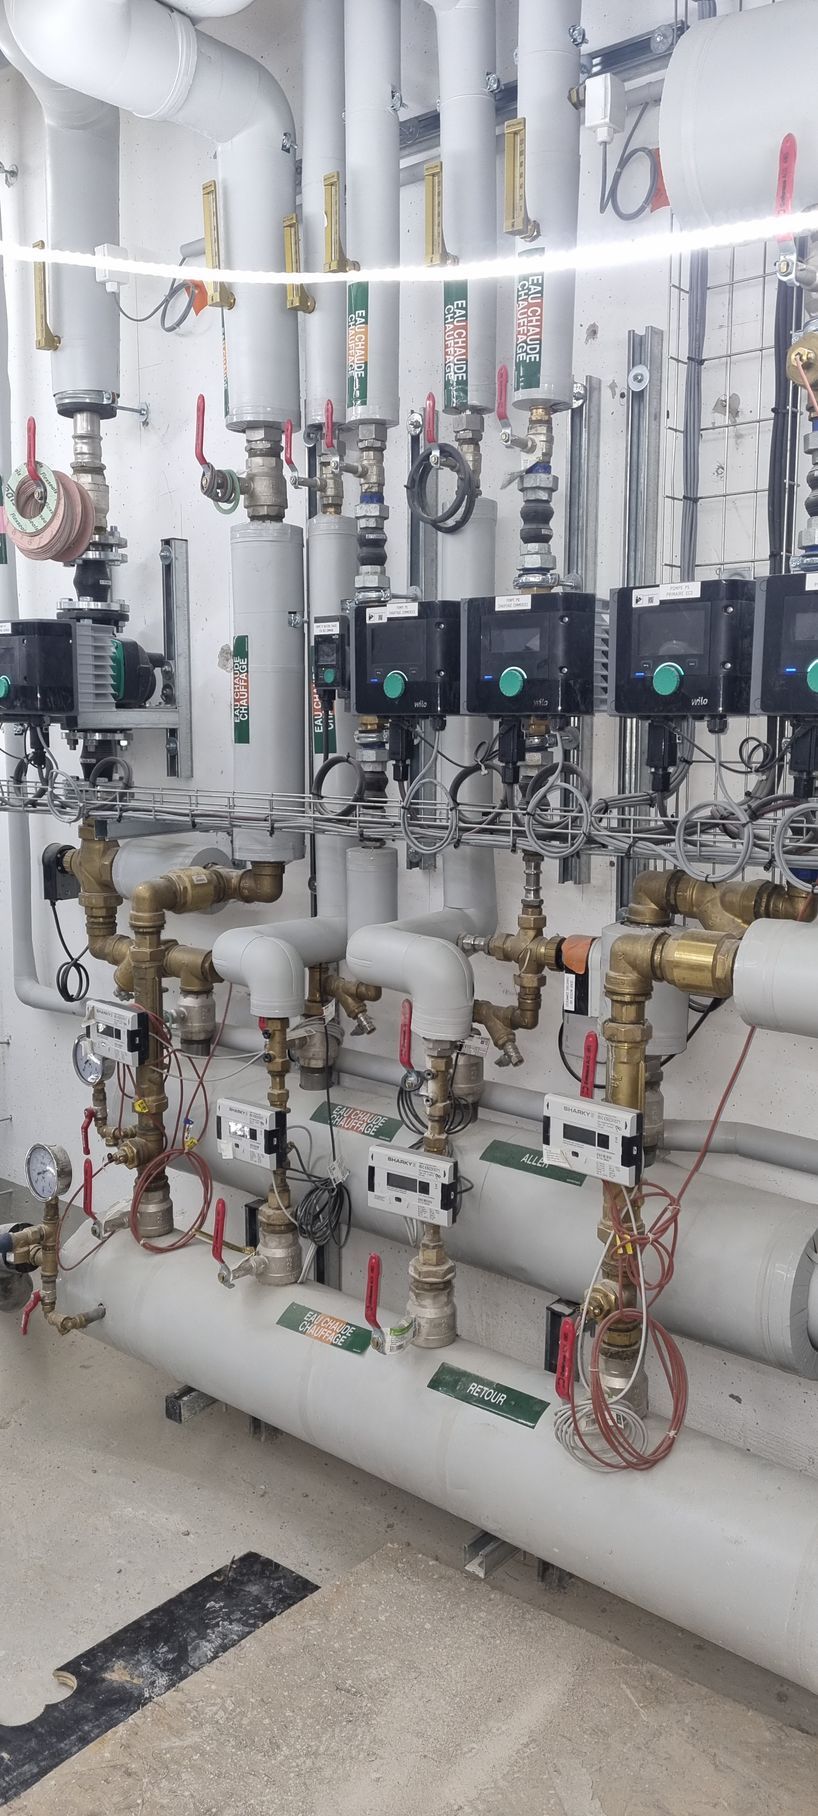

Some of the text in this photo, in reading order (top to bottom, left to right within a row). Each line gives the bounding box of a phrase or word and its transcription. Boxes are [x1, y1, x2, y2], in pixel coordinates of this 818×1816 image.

[516, 280, 528, 363] CHAUFFAGE
[526, 275, 542, 363] EAU CHAUDE
[354, 310, 365, 377] EAU CHAUDE
[444, 305, 454, 381] CHAUFFAGE
[453, 300, 466, 381] EAU CHAUDE
[240, 657, 248, 721] CHAUFFAGE
[691, 696, 708, 706] wilo
[314, 711, 323, 733] EAU
[332, 1105, 388, 1127] EAU CHAUDE
[563, 1106, 591, 1117] SHARKY
[330, 1114, 380, 1136] CHAUFFAGE
[387, 1156, 413, 1167] SHARKY
[298, 1321, 347, 1346] CHAUFFAGE
[303, 1311, 357, 1337] EAU CHAUDE
[466, 1382, 507, 1406] RETOUR
